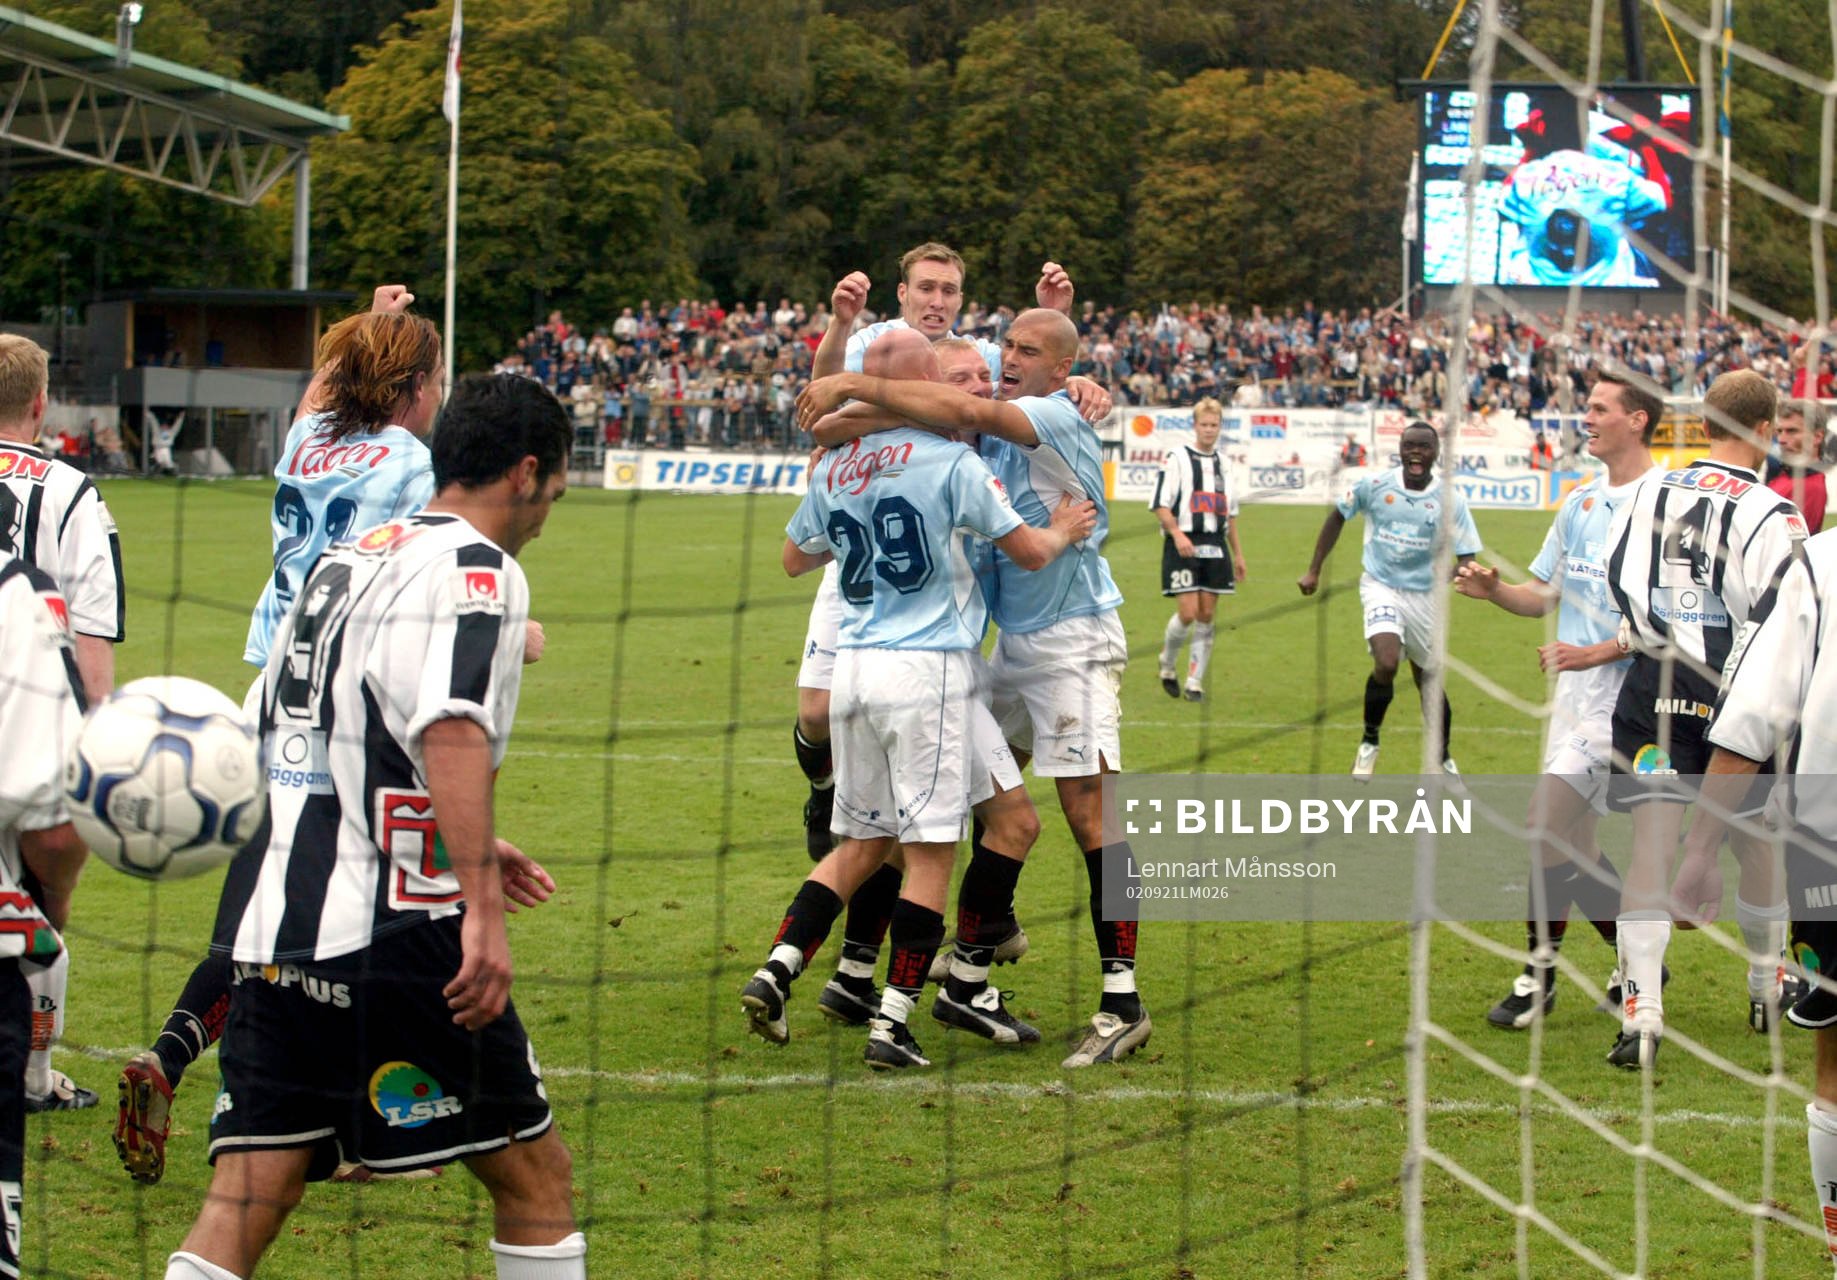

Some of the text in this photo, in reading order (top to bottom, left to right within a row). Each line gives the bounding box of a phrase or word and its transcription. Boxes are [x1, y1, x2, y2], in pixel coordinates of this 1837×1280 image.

[657, 460, 803, 487] TIPSELIT
[828, 438, 913, 495] Pågen
[1663, 469, 1752, 499] ELON
[826, 495, 934, 606] 29
[1662, 496, 1714, 586] 4
[1170, 568, 1193, 588] 20
[385, 1095, 463, 1127] LSR
